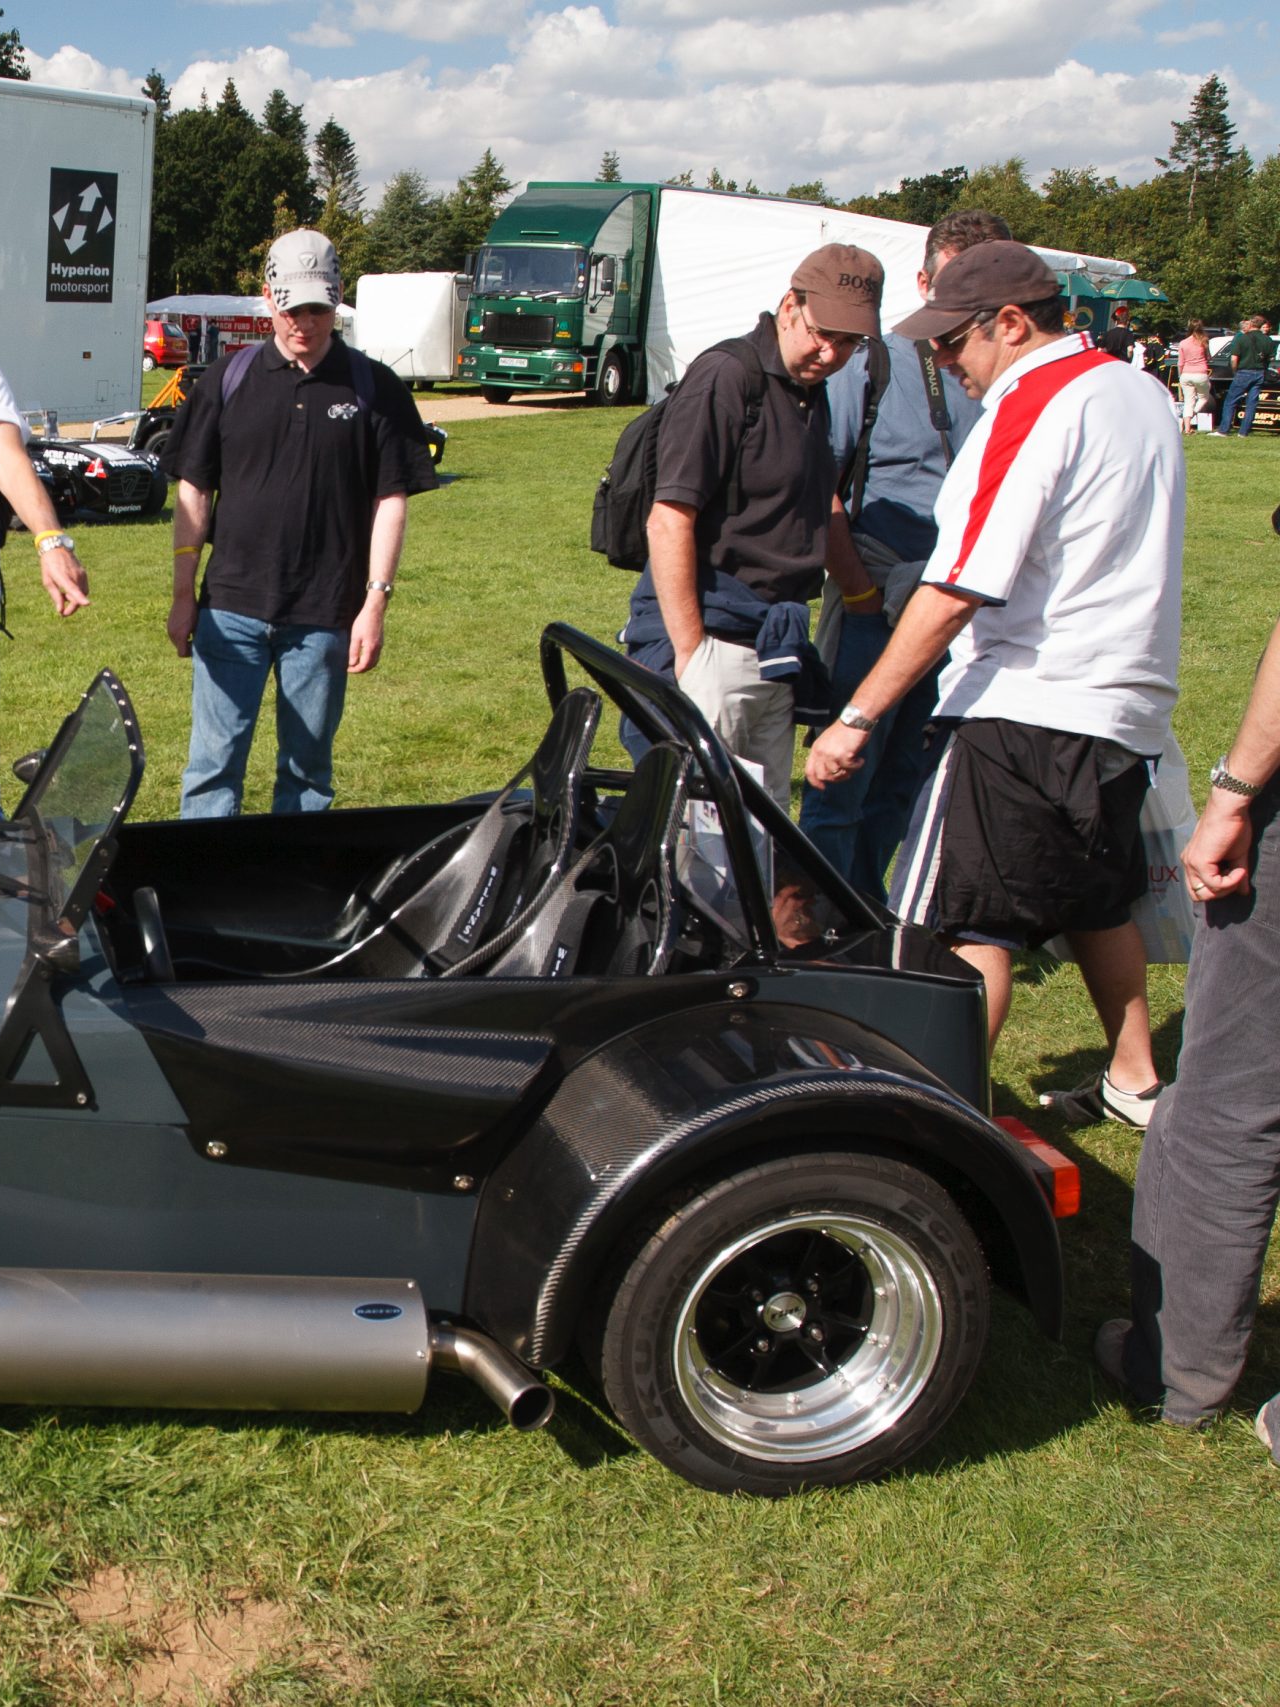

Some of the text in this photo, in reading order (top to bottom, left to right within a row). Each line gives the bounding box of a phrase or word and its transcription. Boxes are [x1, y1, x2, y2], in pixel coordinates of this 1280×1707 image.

[50, 262, 110, 278] Hyperion
[50, 282, 109, 295] motorsport
[924, 356, 940, 397] DYNAX
[108, 504, 142, 514] Hyperion
[463, 865, 498, 935] WILLANS
